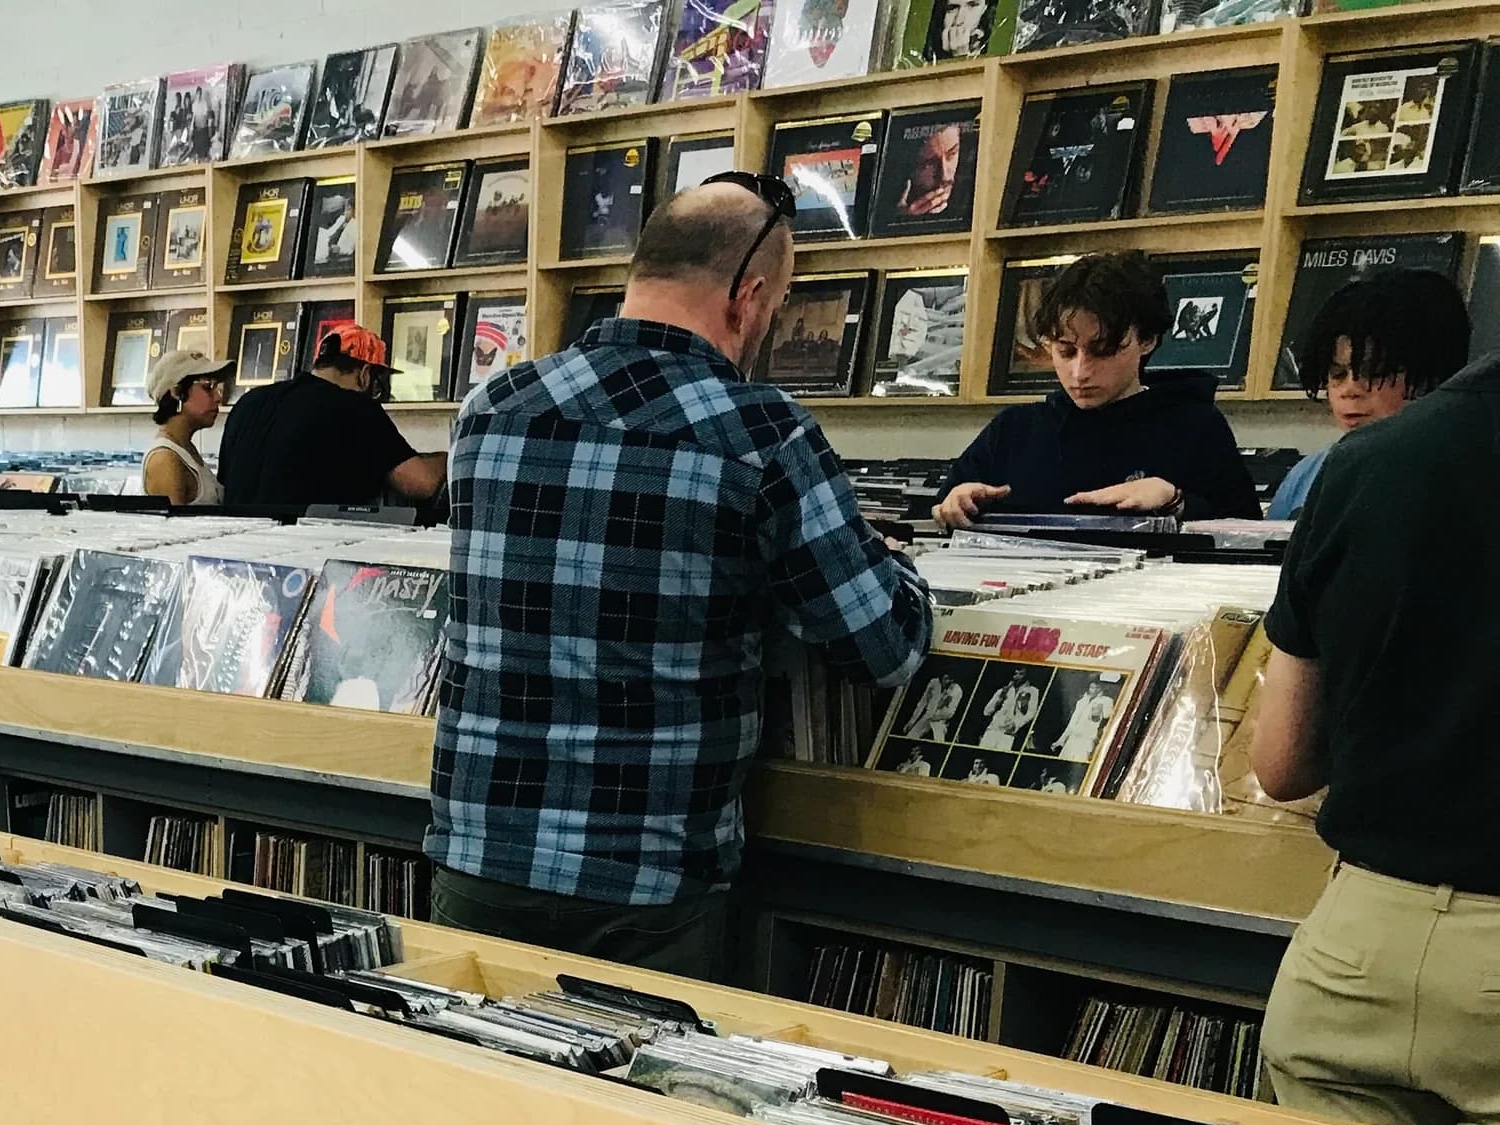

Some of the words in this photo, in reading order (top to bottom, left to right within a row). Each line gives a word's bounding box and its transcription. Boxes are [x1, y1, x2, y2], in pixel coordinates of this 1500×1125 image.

[1303, 249, 1348, 269] MILES
[1352, 247, 1396, 267] DAVIS
[943, 630, 980, 646] HAVING
[981, 633, 1001, 647] FUN
[1058, 642, 1076, 654] ON
